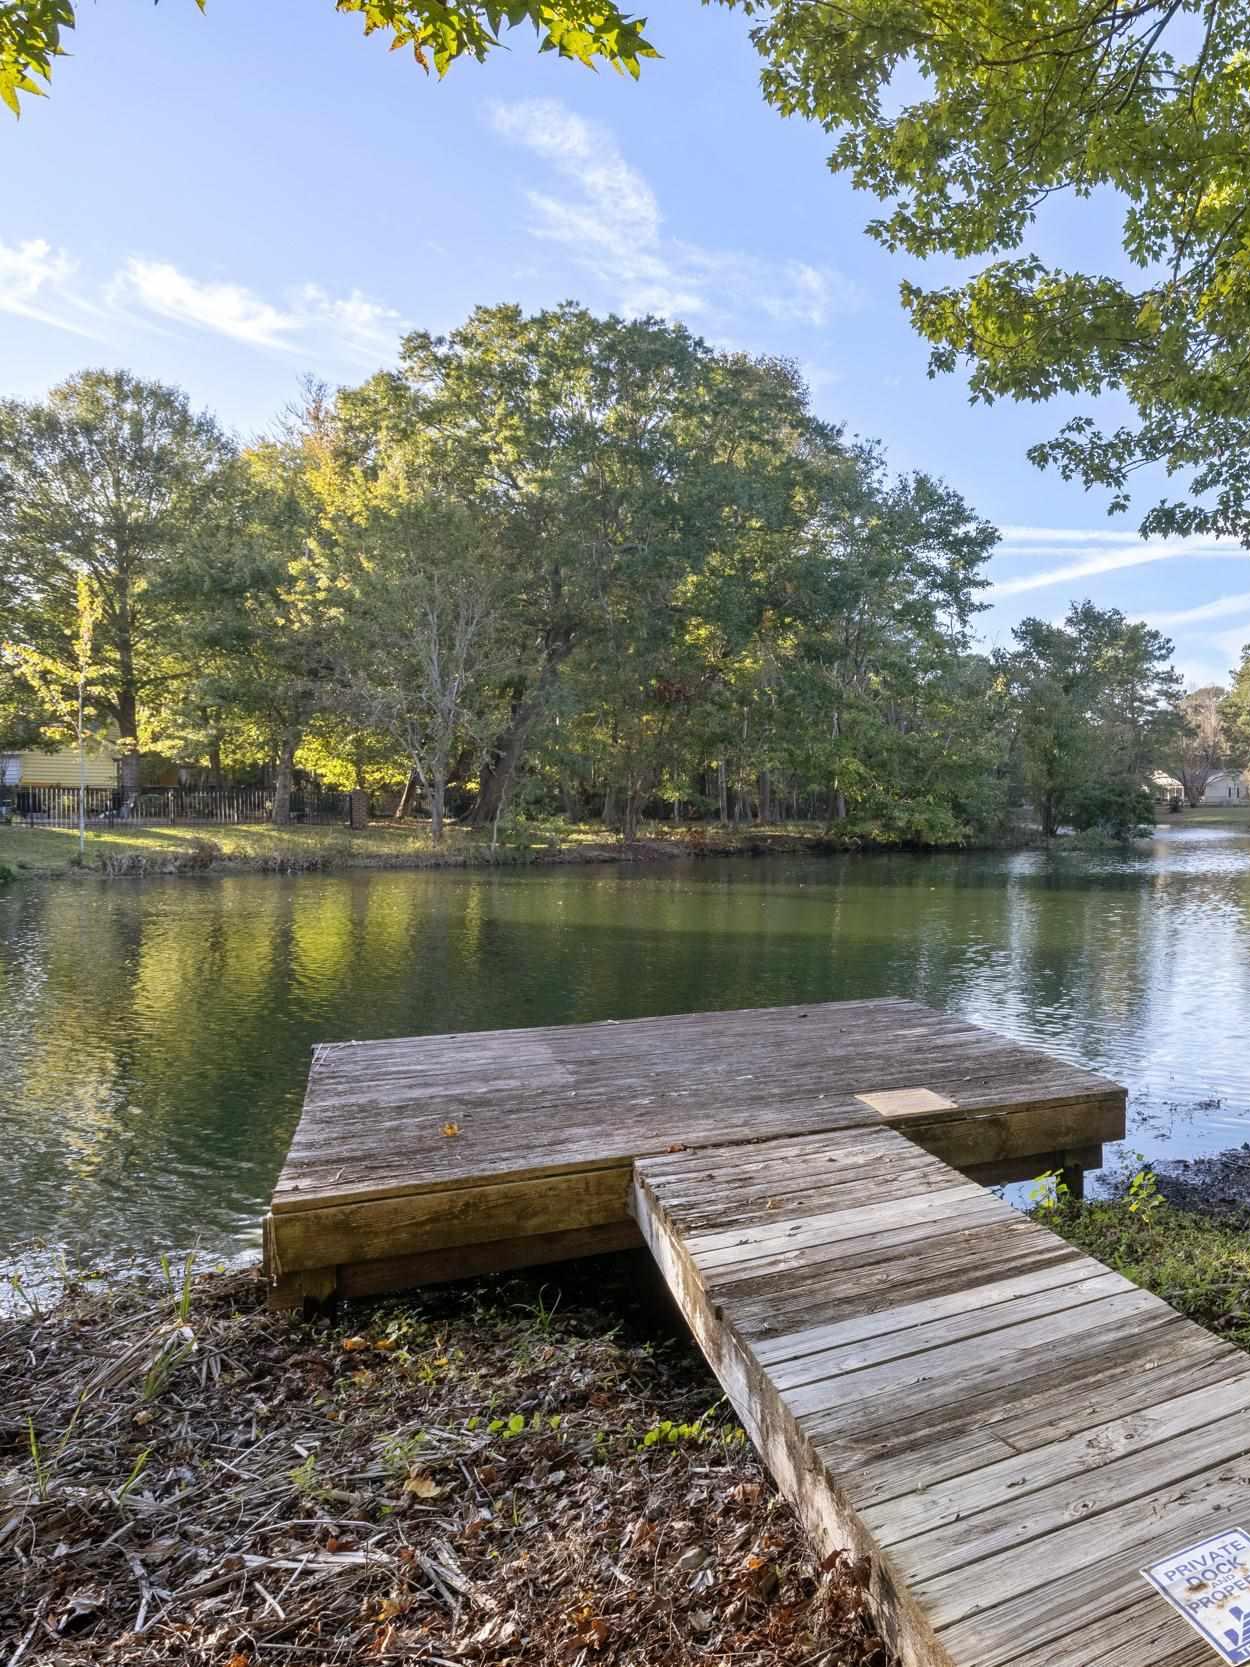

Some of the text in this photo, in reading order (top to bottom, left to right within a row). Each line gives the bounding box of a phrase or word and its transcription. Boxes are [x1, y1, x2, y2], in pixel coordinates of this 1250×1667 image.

[1164, 1540, 1246, 1581] PRIVATE
[1186, 1556, 1245, 1589] DOCK
[1211, 1573, 1235, 1589] AND
